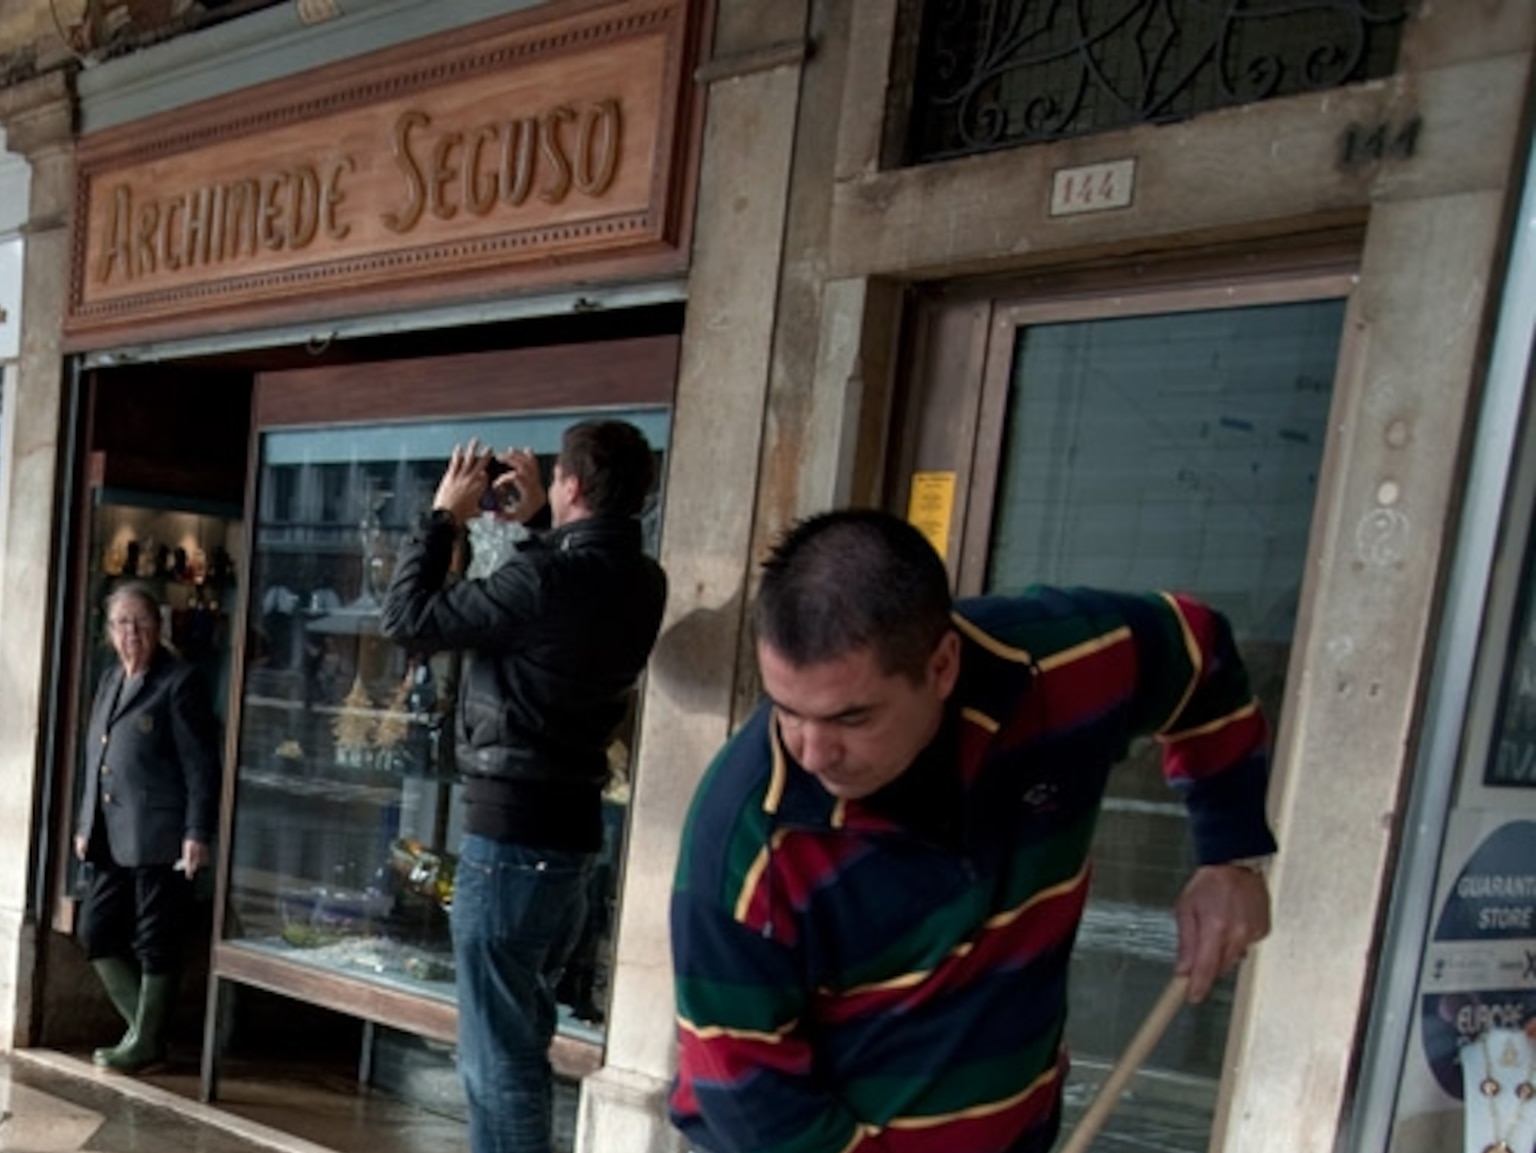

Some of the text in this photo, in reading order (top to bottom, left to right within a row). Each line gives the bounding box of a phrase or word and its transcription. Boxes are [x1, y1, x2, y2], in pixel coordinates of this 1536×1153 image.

[95, 97, 624, 284] ARCHIMEDE SEGUSO
[1063, 170, 1116, 203] 144
[1477, 905, 1533, 930] STORE
